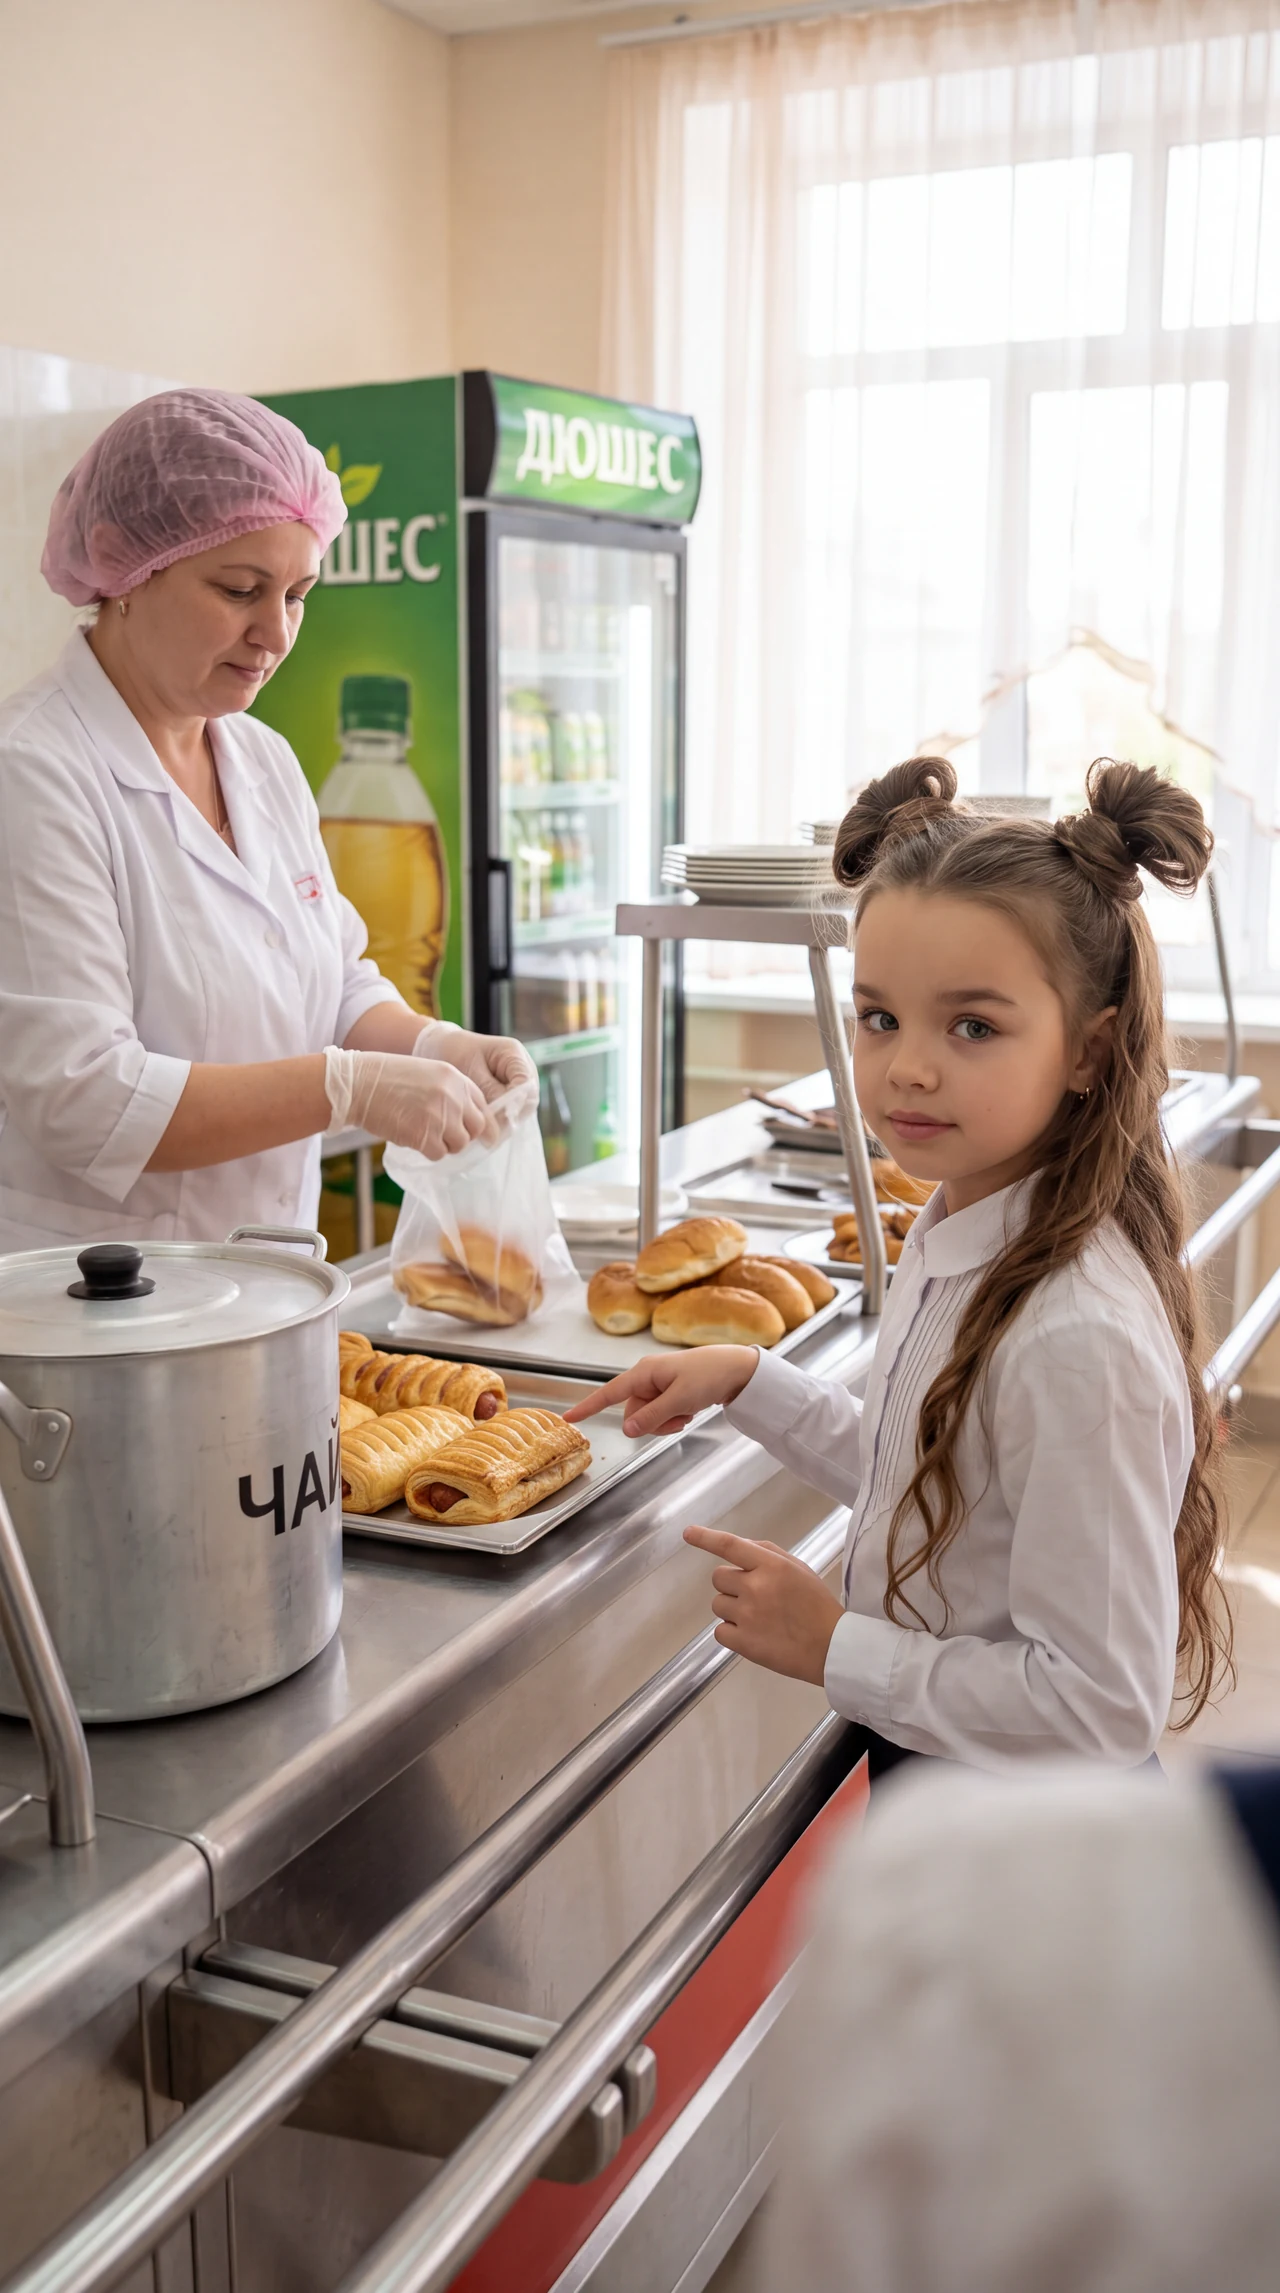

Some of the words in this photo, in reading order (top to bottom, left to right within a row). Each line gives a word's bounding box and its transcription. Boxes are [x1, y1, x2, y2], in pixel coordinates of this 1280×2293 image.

[515, 407, 685, 494] ДЮШЕС
[321, 514, 441, 585] ШЕС
[238, 1412, 341, 1536] ЧАЙ
